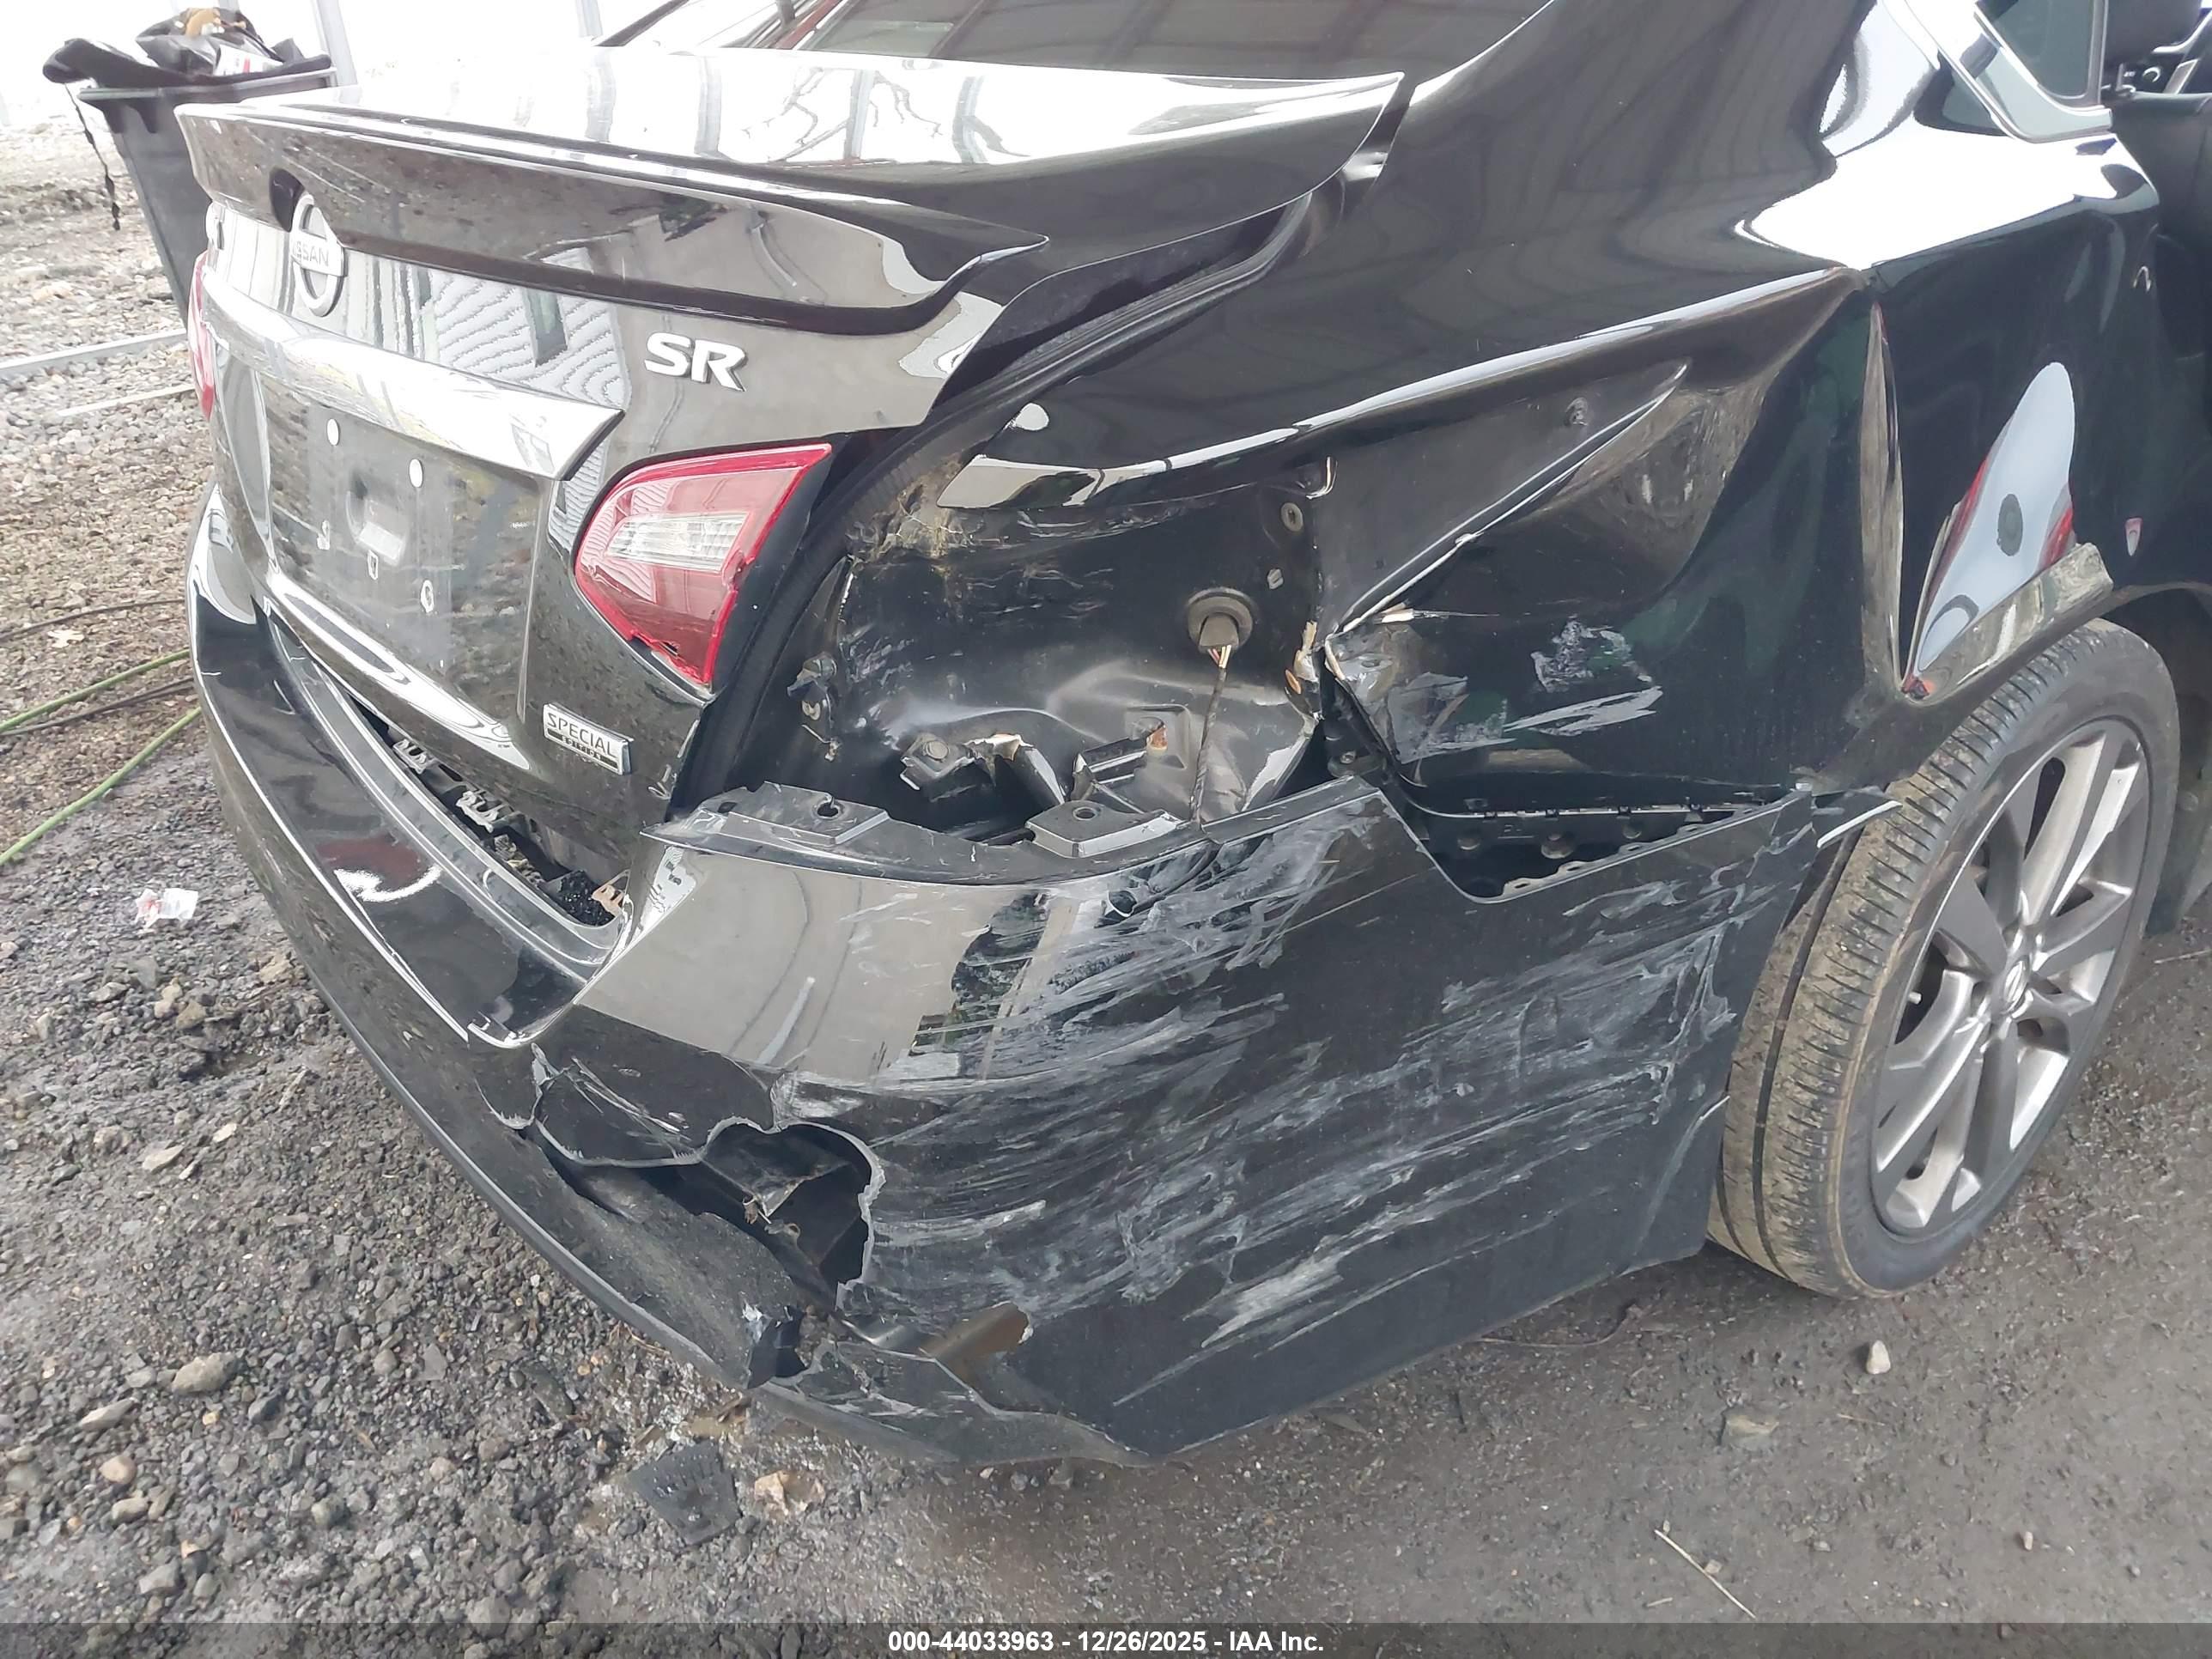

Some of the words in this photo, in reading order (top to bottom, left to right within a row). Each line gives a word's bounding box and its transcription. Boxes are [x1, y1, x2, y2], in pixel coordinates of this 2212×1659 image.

[291, 240, 330, 267] SSAN
[644, 332, 748, 392] SR
[547, 712, 617, 758] SPECIAL
